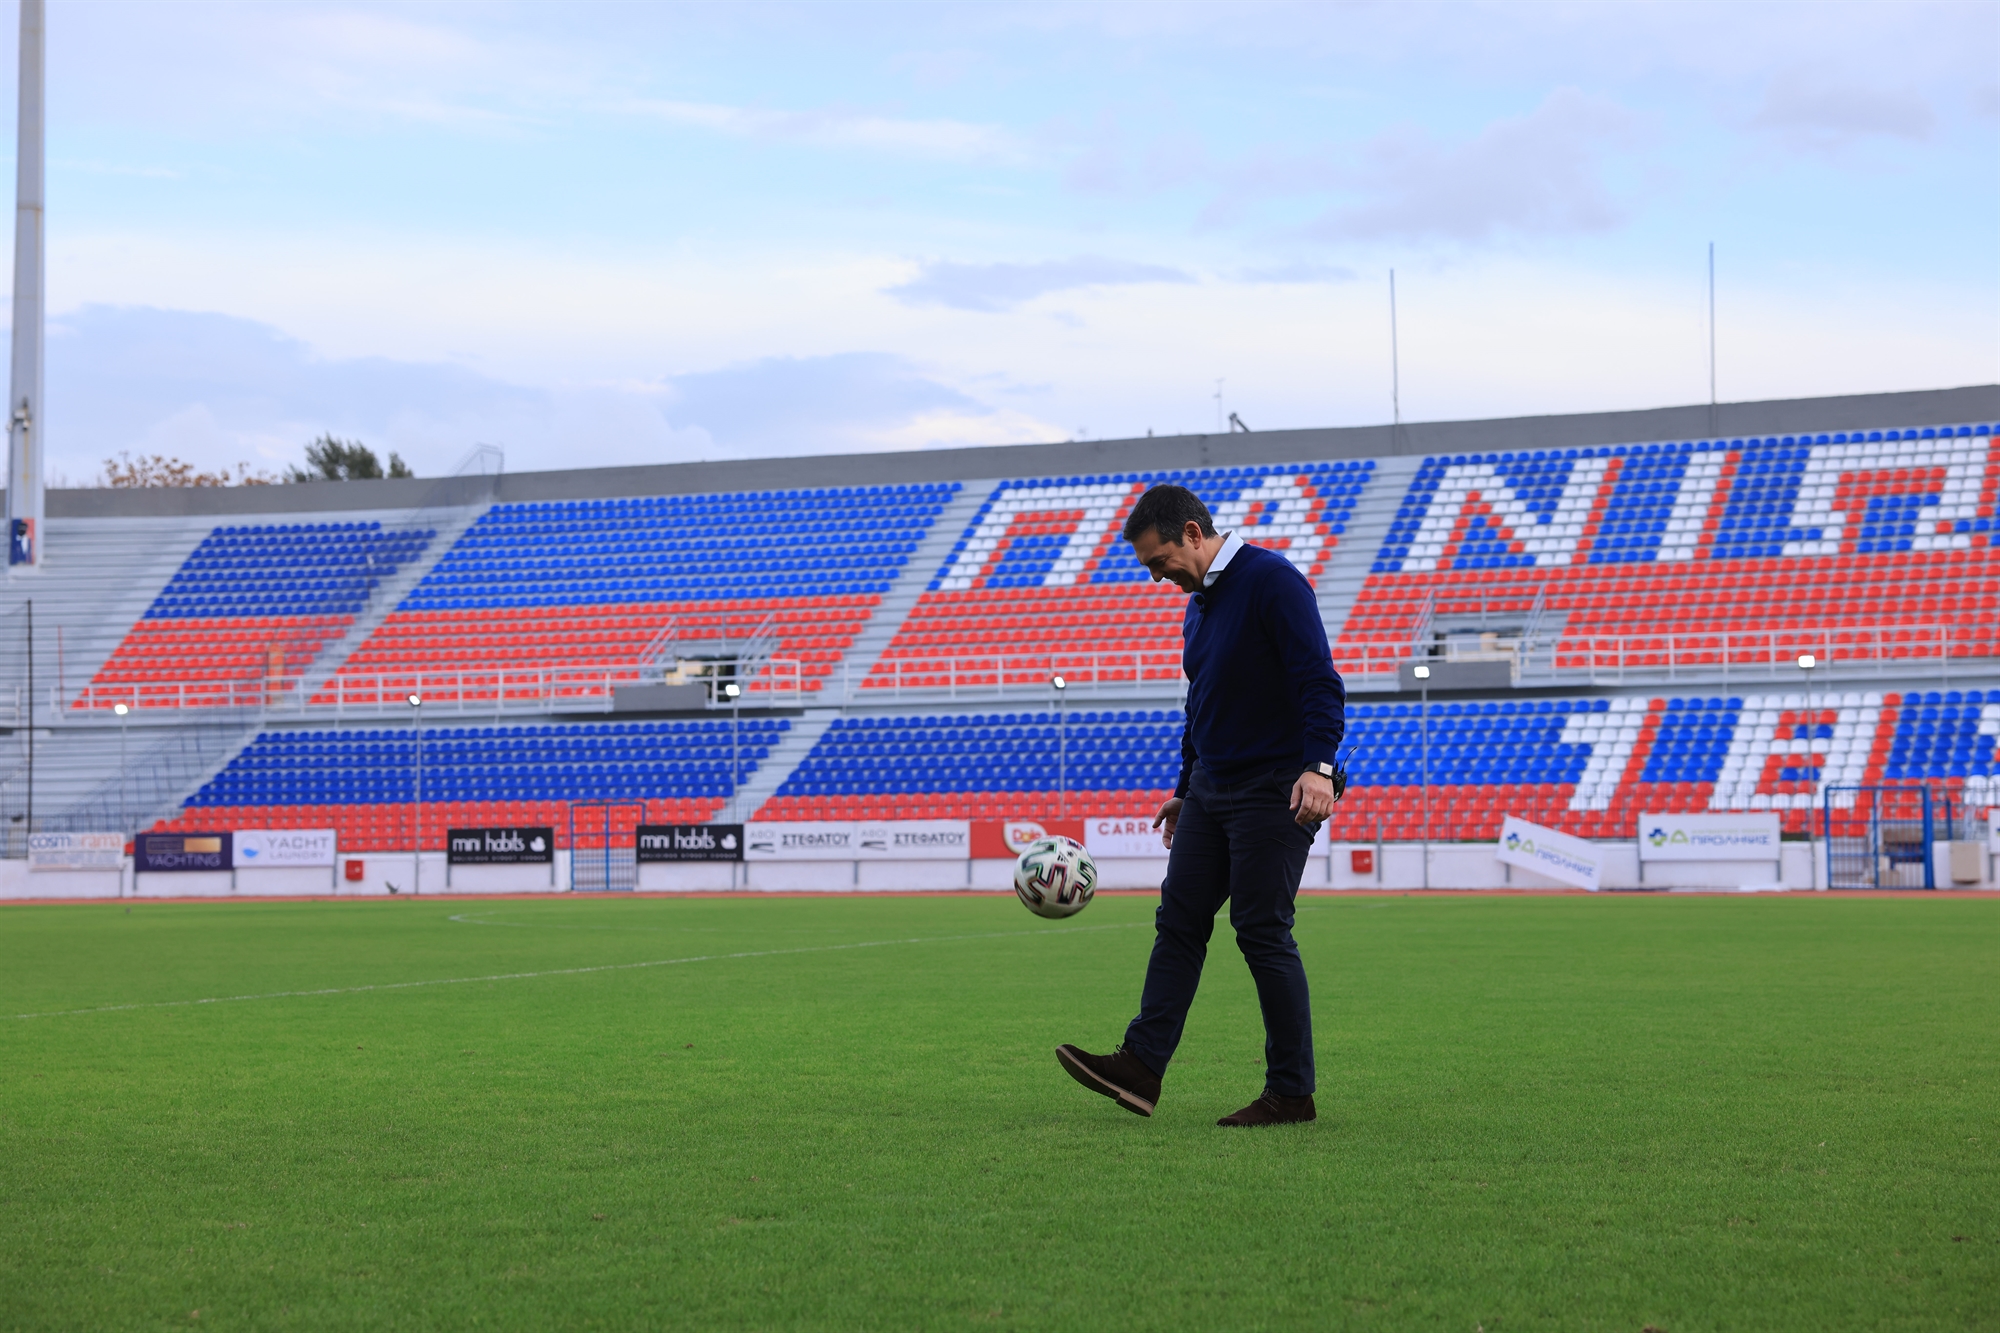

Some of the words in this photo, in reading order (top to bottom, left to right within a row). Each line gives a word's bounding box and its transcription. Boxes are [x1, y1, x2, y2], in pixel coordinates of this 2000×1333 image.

[266, 836, 330, 850] YACHT
[452, 838, 481, 852] mini
[485, 829, 526, 852] habits
[640, 834, 670, 849] mini
[674, 826, 716, 849] habits
[782, 832, 851, 846] ΣΤΕΦΑΤΟΥ
[894, 832, 965, 845] ΣΤΕΦΑΤΟΥ
[146, 853, 222, 867] YACHTING
